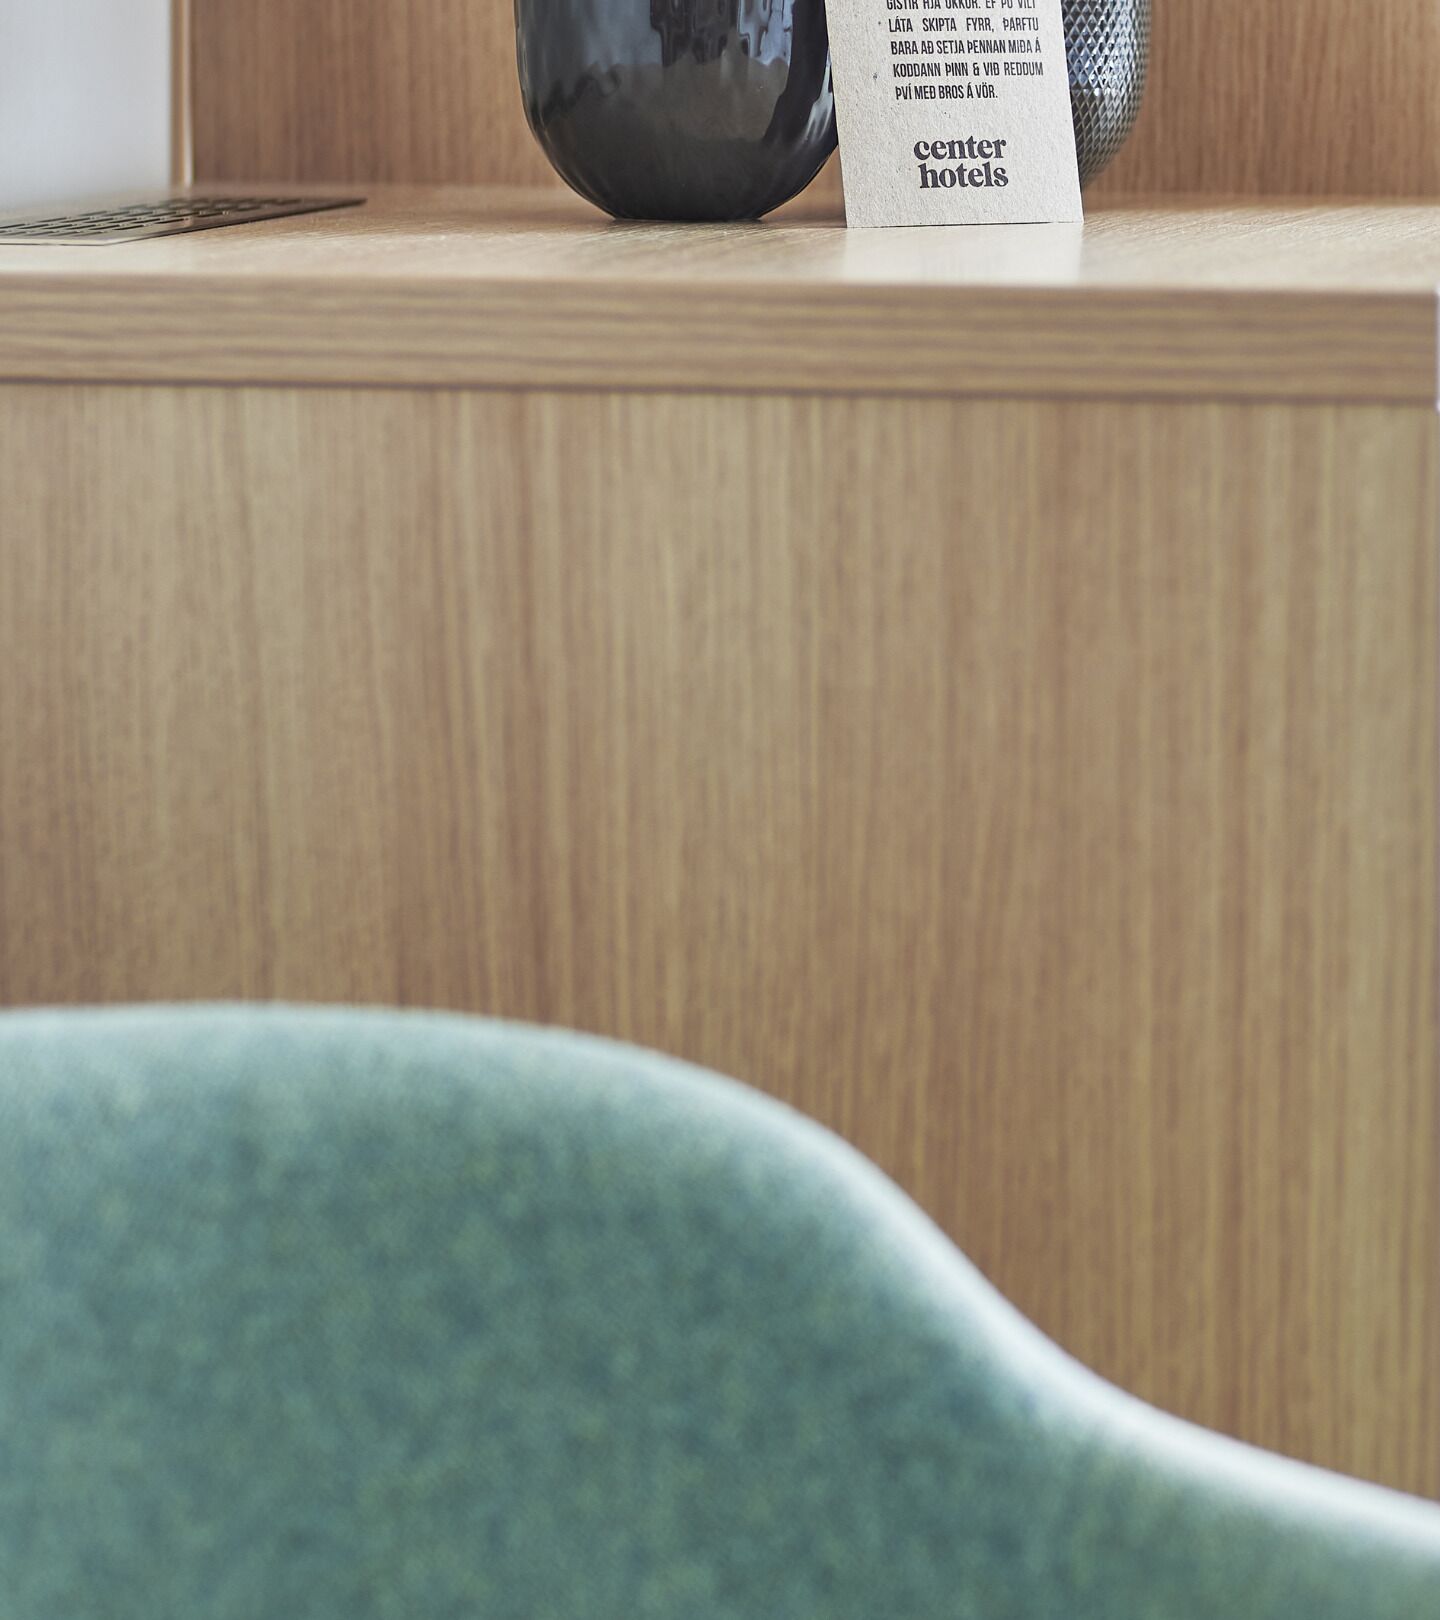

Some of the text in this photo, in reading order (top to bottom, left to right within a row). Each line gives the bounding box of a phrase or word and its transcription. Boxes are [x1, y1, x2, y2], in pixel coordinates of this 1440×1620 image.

[888, 16, 1039, 33] LÁTA SKIPTA FYRR, ÞARFTU
[890, 36, 1042, 55] BARA AÐ SETJA ÞENNAN MIÐA Á
[892, 61, 1044, 78] KODDANN ÞINN & VIÐ REDDUM
[895, 81, 999, 101] ÞVÍ MEÐ BROS Á VÖR.
[914, 135, 1007, 161] center
[918, 161, 1009, 188] hotels
